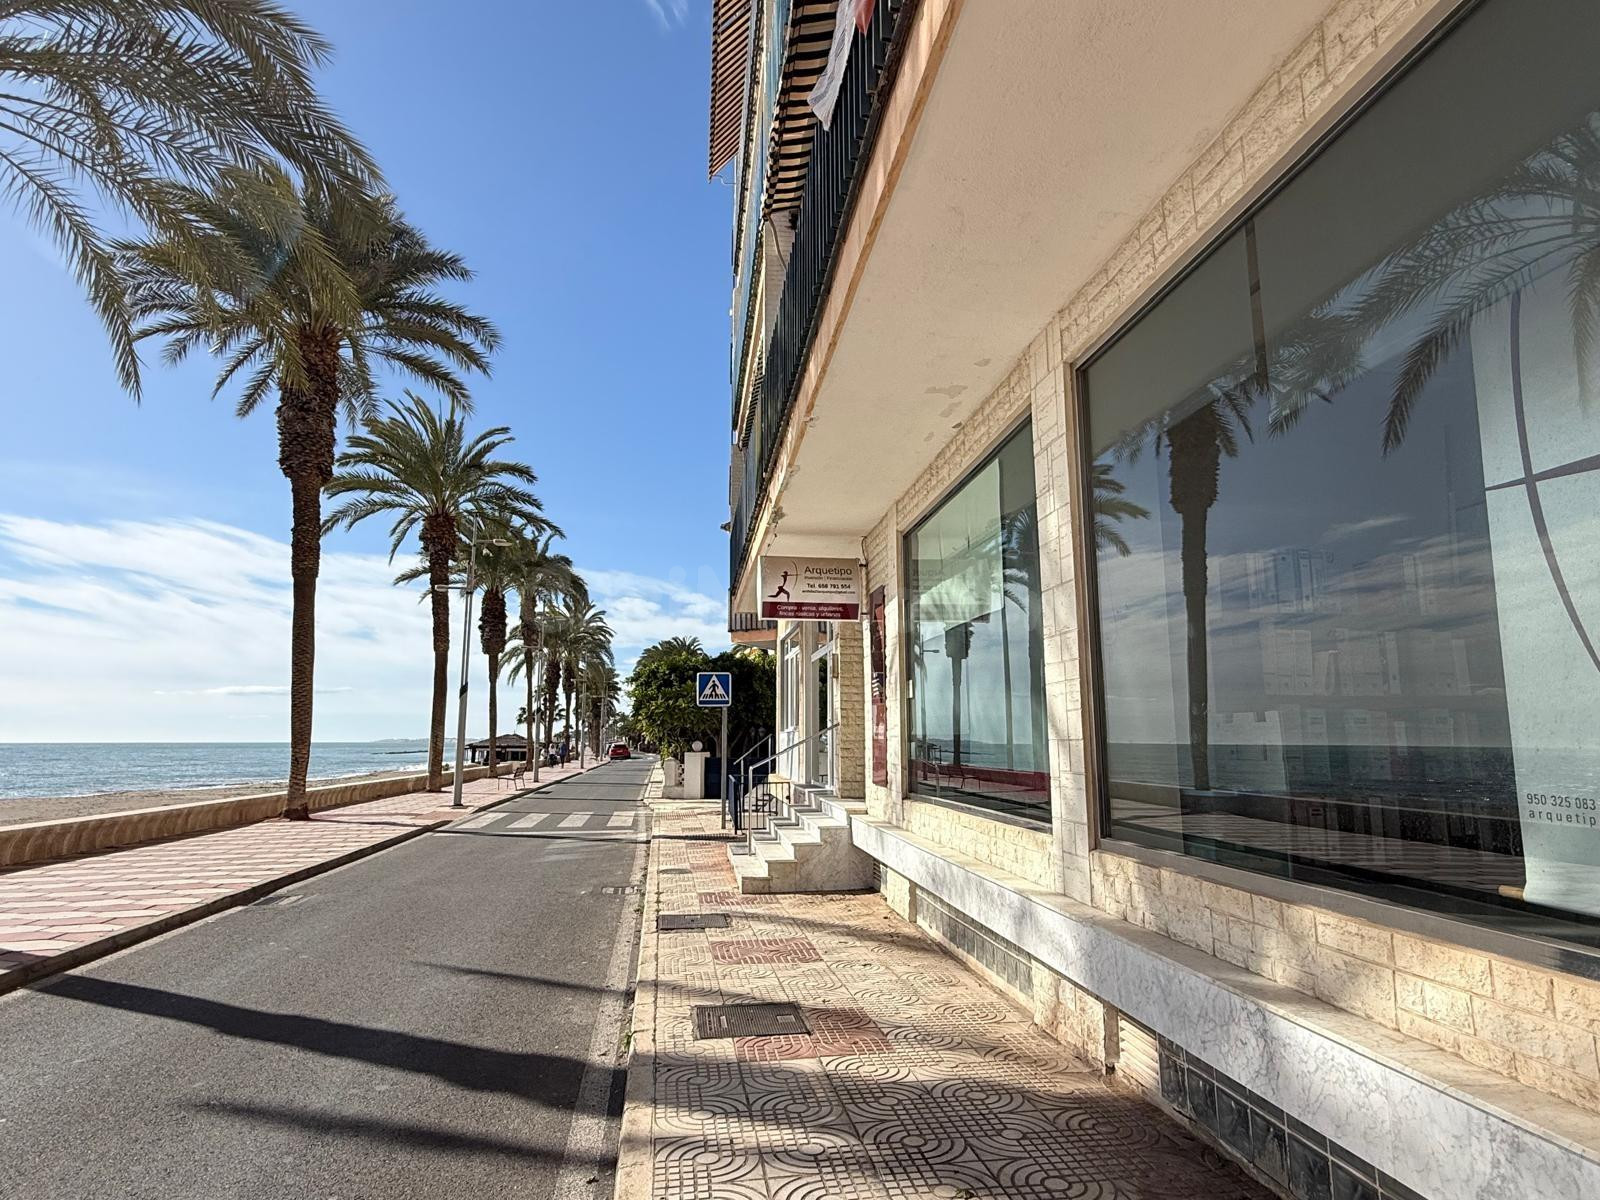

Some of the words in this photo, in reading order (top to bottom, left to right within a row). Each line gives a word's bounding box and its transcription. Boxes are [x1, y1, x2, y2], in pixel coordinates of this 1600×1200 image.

[804, 566, 853, 576] Arquetipo
[1526, 793, 1547, 806] 950
[1550, 795, 1571, 808] 325
[1575, 797, 1597, 811] 083
